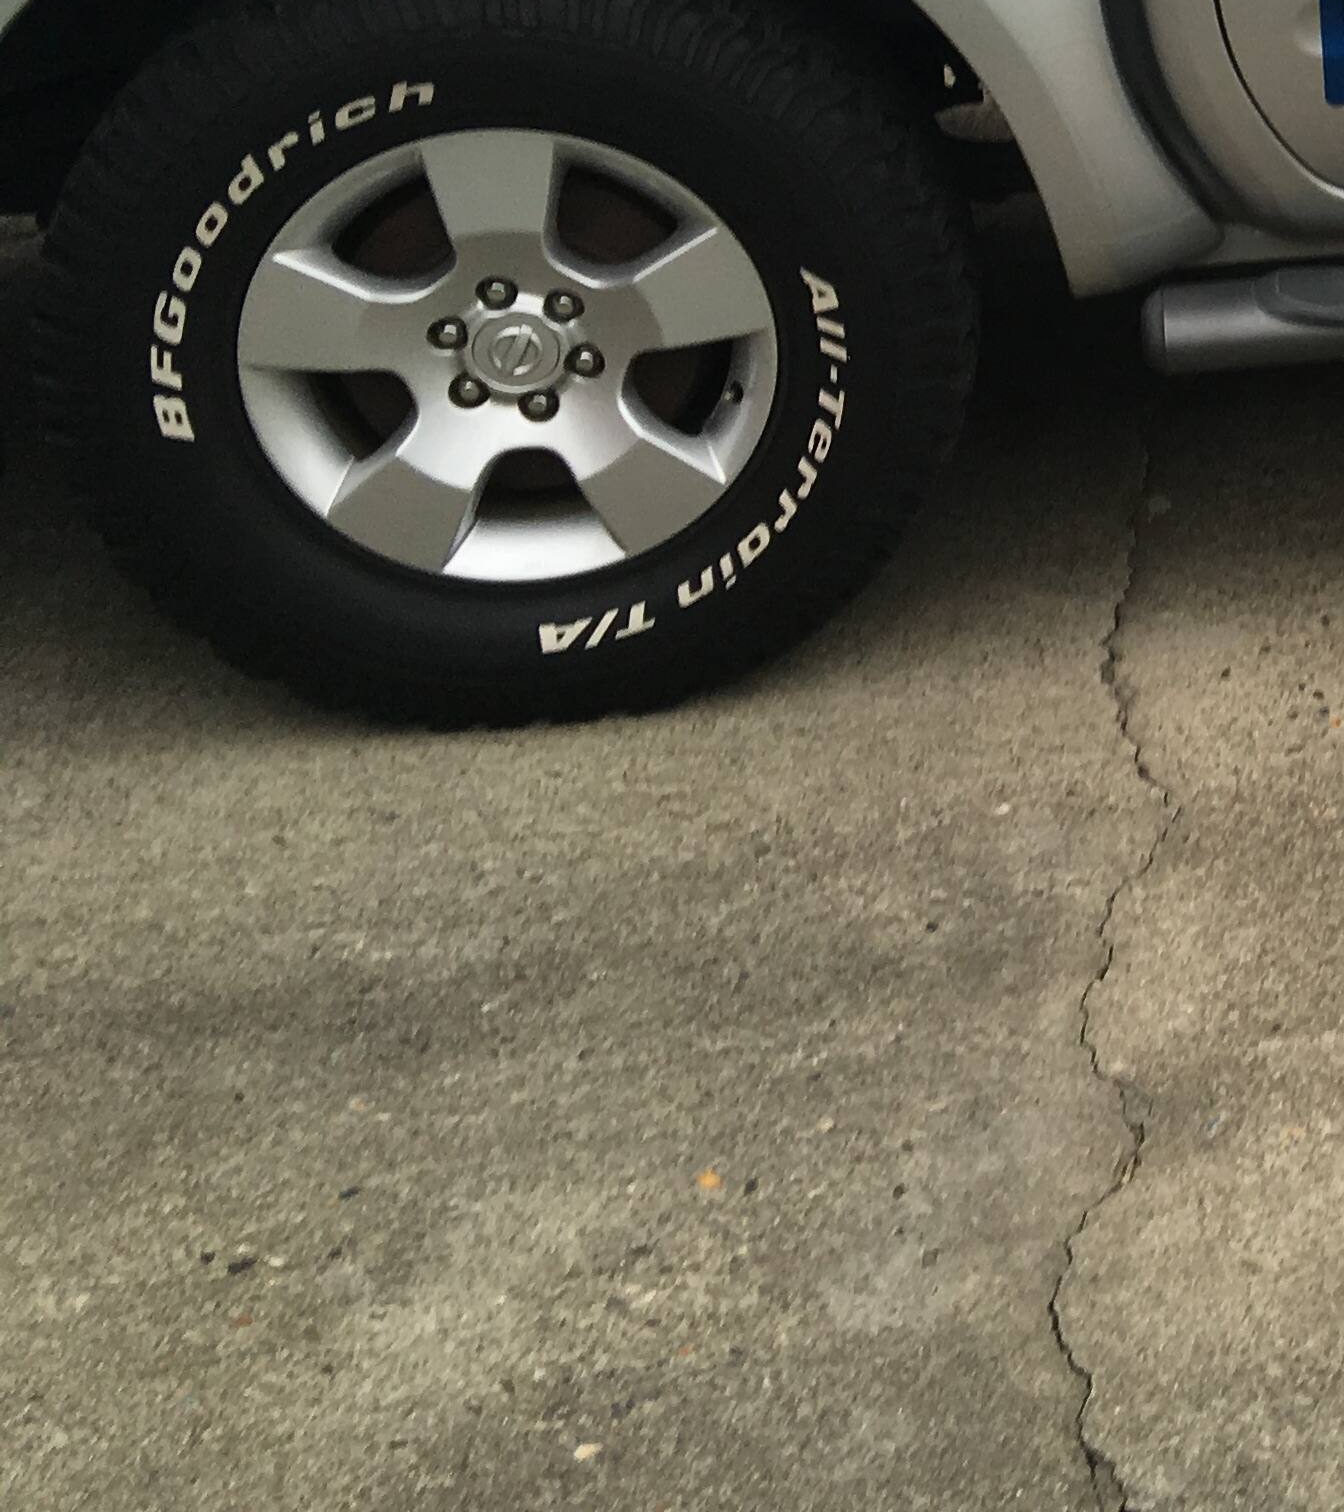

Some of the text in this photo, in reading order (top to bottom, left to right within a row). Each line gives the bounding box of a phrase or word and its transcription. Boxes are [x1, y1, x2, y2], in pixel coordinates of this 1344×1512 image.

[149, 80, 436, 443] BFGoodrich
[537, 266, 849, 655] All-Terrain T/A
